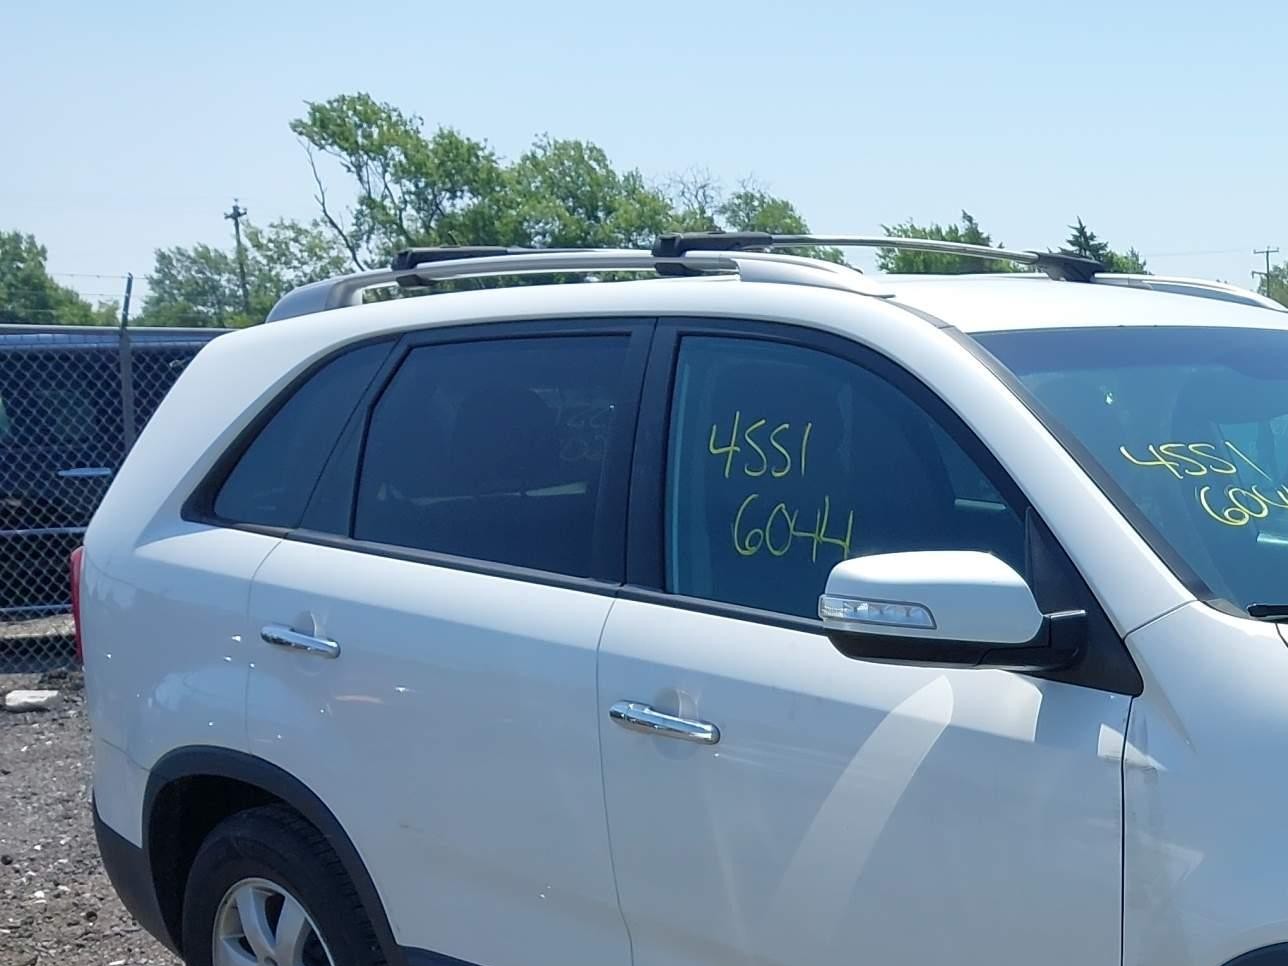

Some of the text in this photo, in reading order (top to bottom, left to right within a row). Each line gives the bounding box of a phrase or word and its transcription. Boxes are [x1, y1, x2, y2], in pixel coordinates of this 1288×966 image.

[708, 410, 812, 478] 4551
[1119, 441, 1272, 480] 4551
[733, 493, 854, 564] 6044
